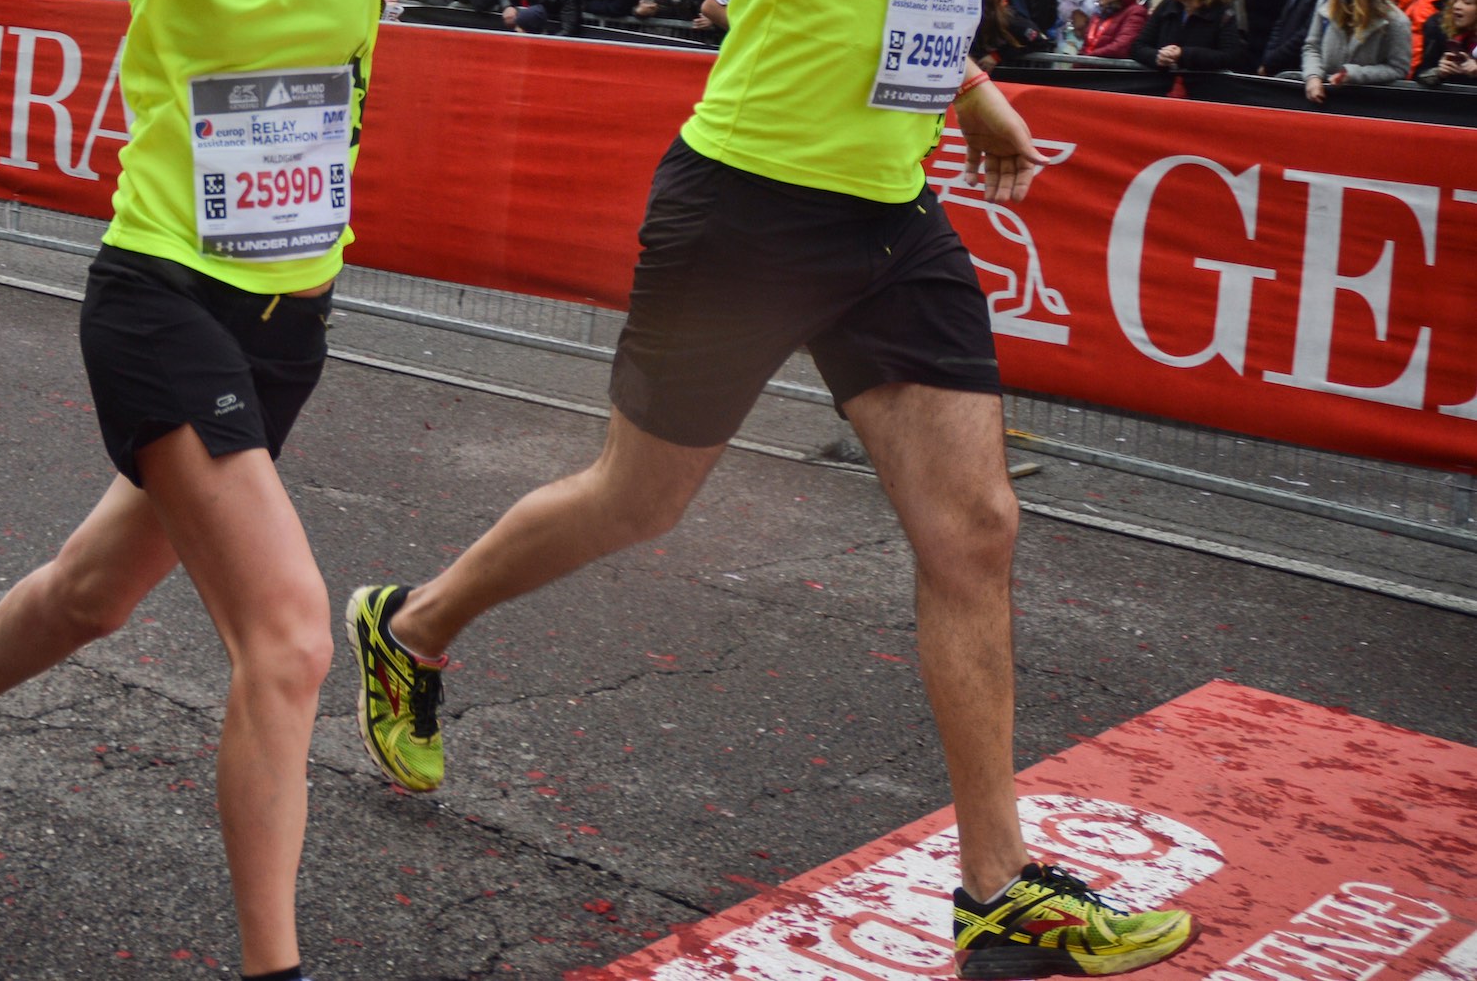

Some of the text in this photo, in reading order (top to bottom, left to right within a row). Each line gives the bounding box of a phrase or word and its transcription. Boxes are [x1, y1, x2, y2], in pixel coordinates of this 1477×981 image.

[906, 33, 962, 68] 2599A
[290, 84, 325, 95] MILANO
[898, 91, 931, 103] UNDER
[216, 128, 245, 142] europ
[251, 120, 297, 135] RELAY
[197, 138, 246, 149] assistance
[252, 131, 318, 146] MARATHON
[236, 166, 324, 209] 2599D
[237, 230, 340, 251] UNDER ARMOUR
[1107, 153, 1477, 421] GE
